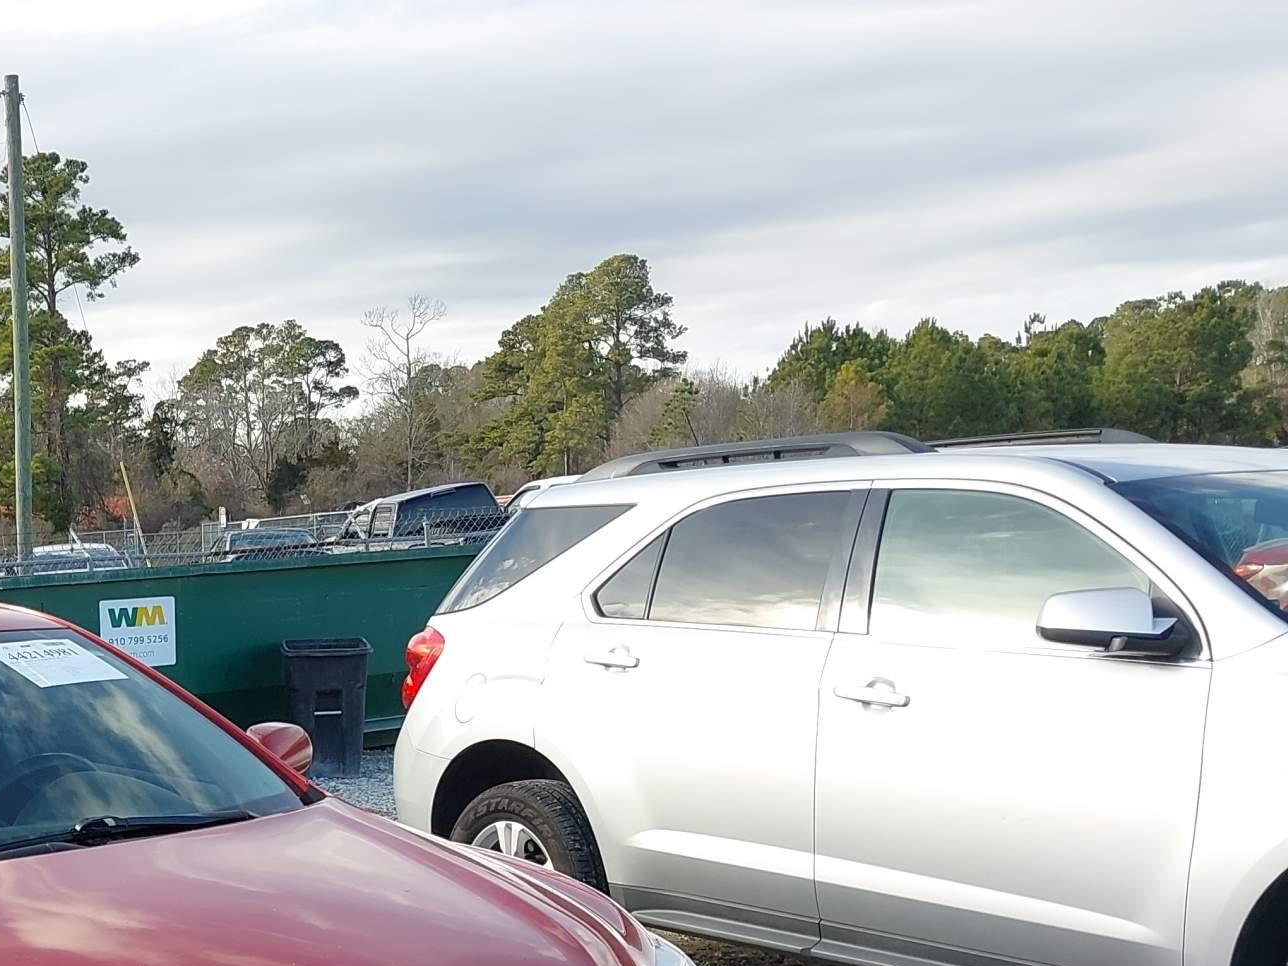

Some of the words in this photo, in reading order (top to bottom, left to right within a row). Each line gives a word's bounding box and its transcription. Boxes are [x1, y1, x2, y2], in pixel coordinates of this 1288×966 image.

[108, 606, 166, 628] WM
[127, 636, 145, 646] 799
[146, 634, 169, 645] 5256
